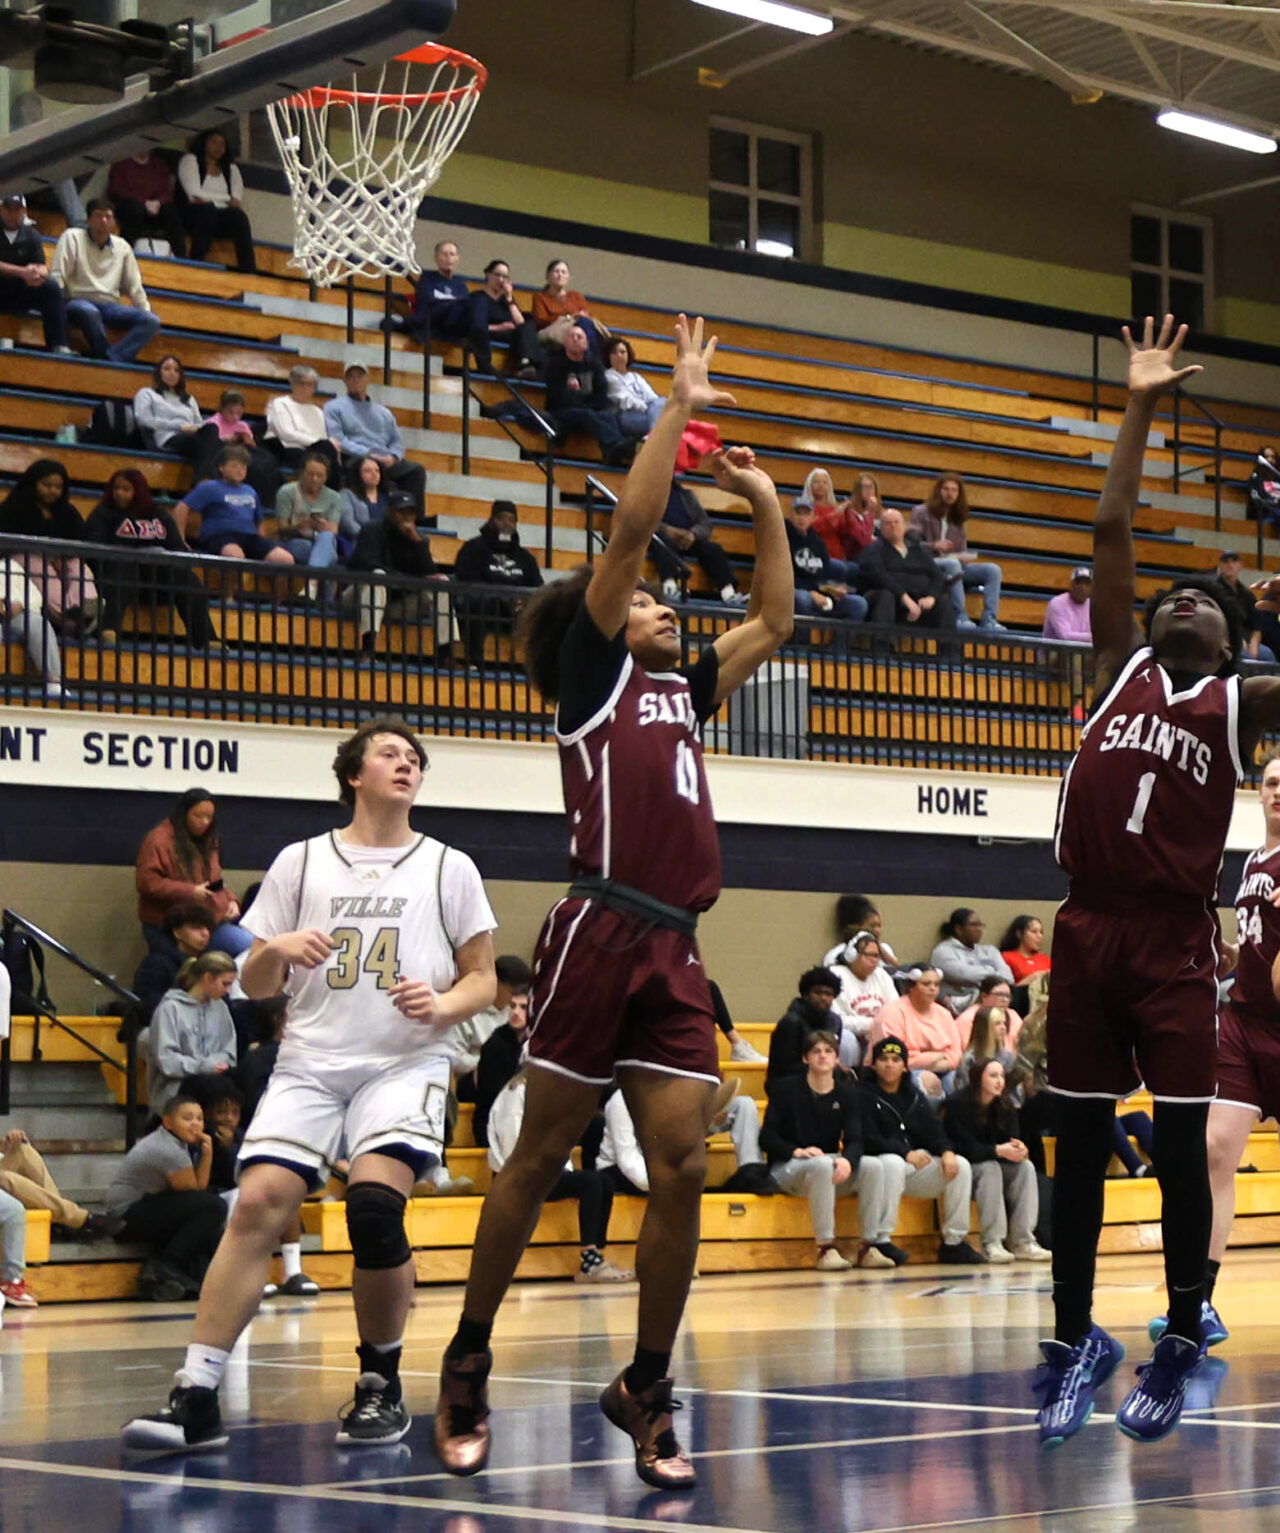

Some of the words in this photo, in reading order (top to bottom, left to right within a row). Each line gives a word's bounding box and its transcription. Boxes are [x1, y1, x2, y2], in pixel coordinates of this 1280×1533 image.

[83, 731, 239, 773] SECTION
[1099, 713, 1212, 786] SAINTS
[918, 784, 988, 817] HOME
[1126, 771, 1157, 835] 1
[331, 896, 408, 919] VILLE
[1236, 904, 1263, 946] 34
[327, 927, 400, 990] 34
